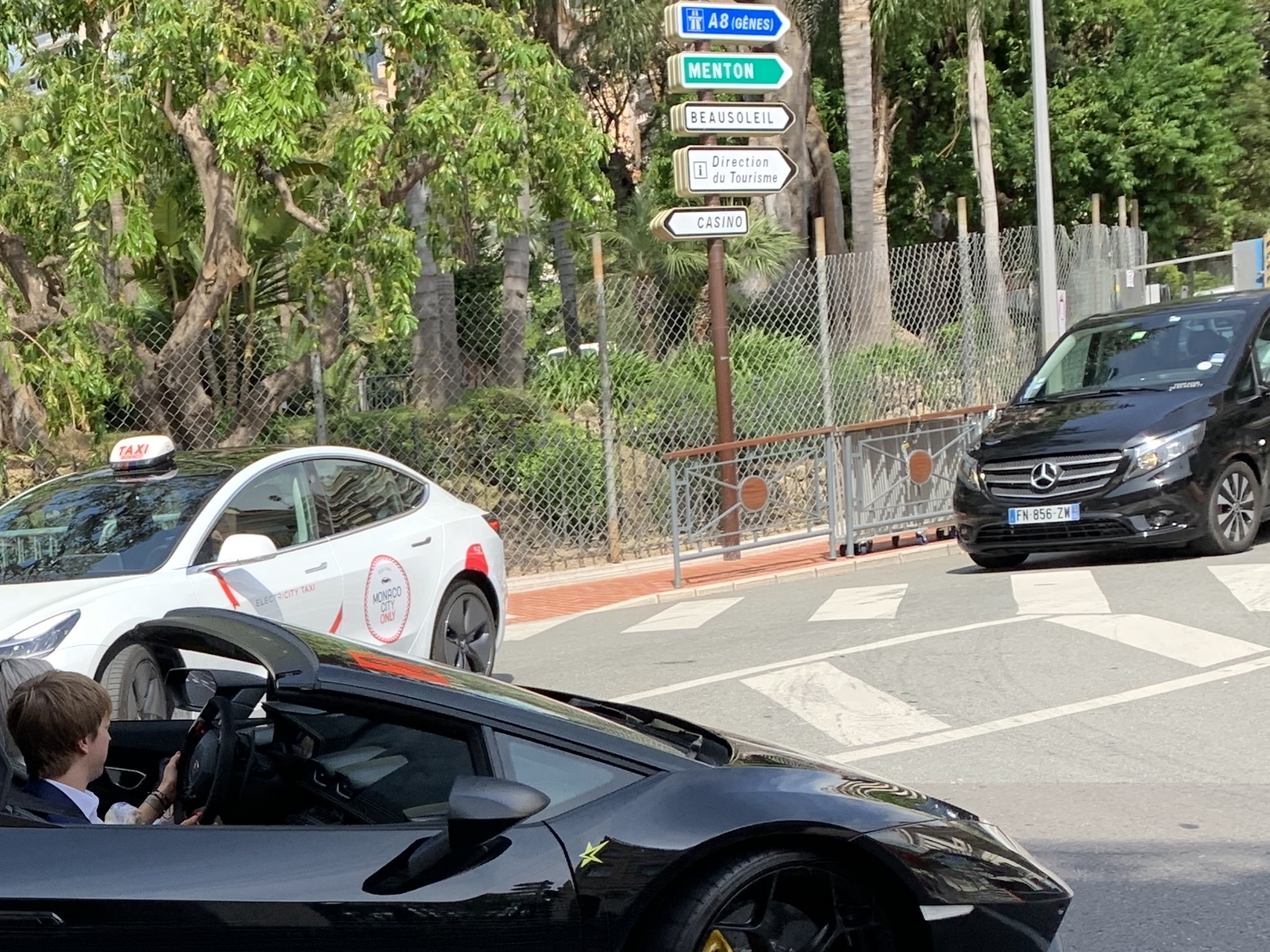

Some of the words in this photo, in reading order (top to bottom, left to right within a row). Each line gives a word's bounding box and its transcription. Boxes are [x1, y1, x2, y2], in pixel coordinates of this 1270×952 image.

[708, 12, 729, 29] A8
[731, 14, 774, 32] (GÊNES)
[688, 62, 754, 79] MENTON
[690, 111, 774, 124] BEAUSOLEIL
[712, 155, 769, 168] Direction
[712, 171, 726, 184] du
[730, 171, 778, 184] Tourisme
[697, 215, 743, 229] CASINO
[119, 444, 150, 456] TAXI
[300, 584, 316, 594] TAXI
[372, 585, 402, 605] MONACO
[380, 599, 396, 613] CITY
[380, 609, 397, 624] ONLY
